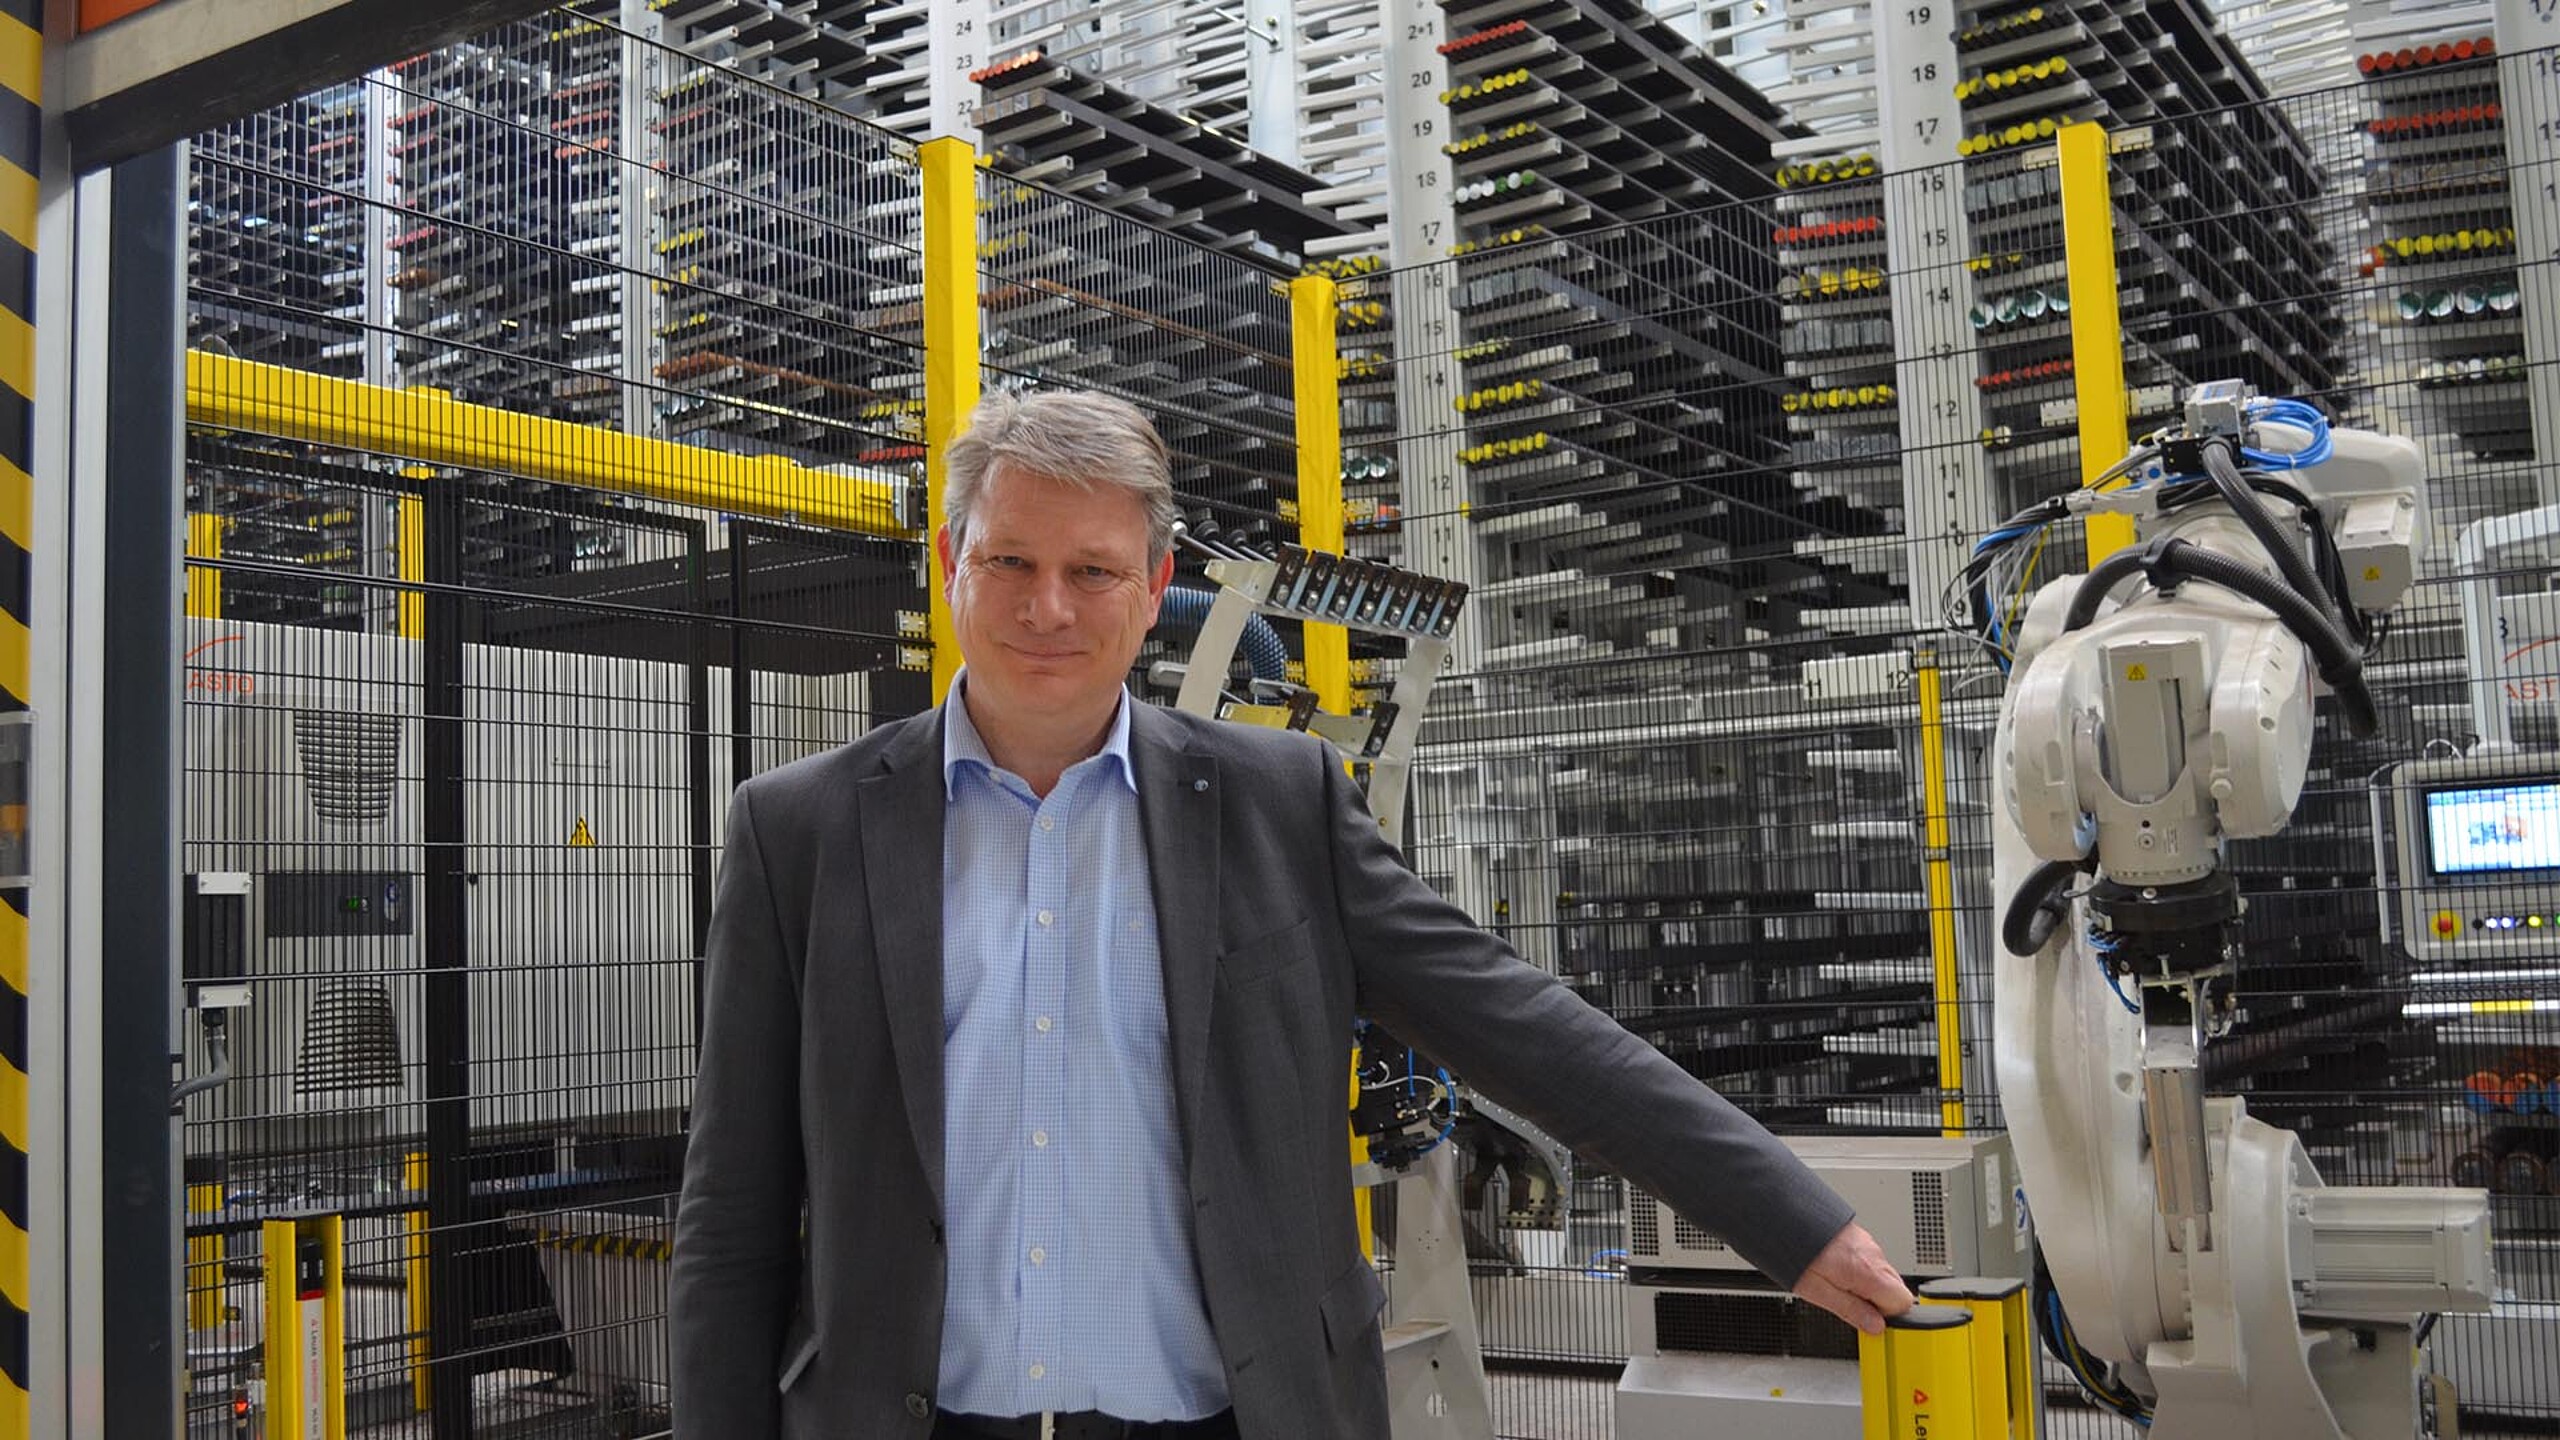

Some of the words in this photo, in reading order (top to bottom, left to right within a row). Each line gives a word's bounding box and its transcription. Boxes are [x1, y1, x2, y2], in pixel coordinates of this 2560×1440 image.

[1907, 7, 1931, 25] 19
[956, 20, 972, 36] 24
[957, 54, 973, 70] 23
[1411, 71, 1431, 88] 20
[1912, 64, 1937, 82] 18
[958, 100, 973, 116] 22
[1413, 120, 1433, 138] 19
[1915, 117, 1939, 136] 17
[1417, 171, 1437, 188] 18
[1920, 174, 1944, 193] 16
[1421, 221, 1441, 238] 17
[1923, 229, 1947, 247] 15
[1926, 287, 1950, 305] 14
[1424, 320, 1443, 336] 15
[1933, 400, 1957, 419] 12
[1939, 462, 1960, 479] 11
[1431, 475, 1450, 491] 12
[1887, 671, 1909, 690] 12
[1915, 1414, 1929, 1440] Le
